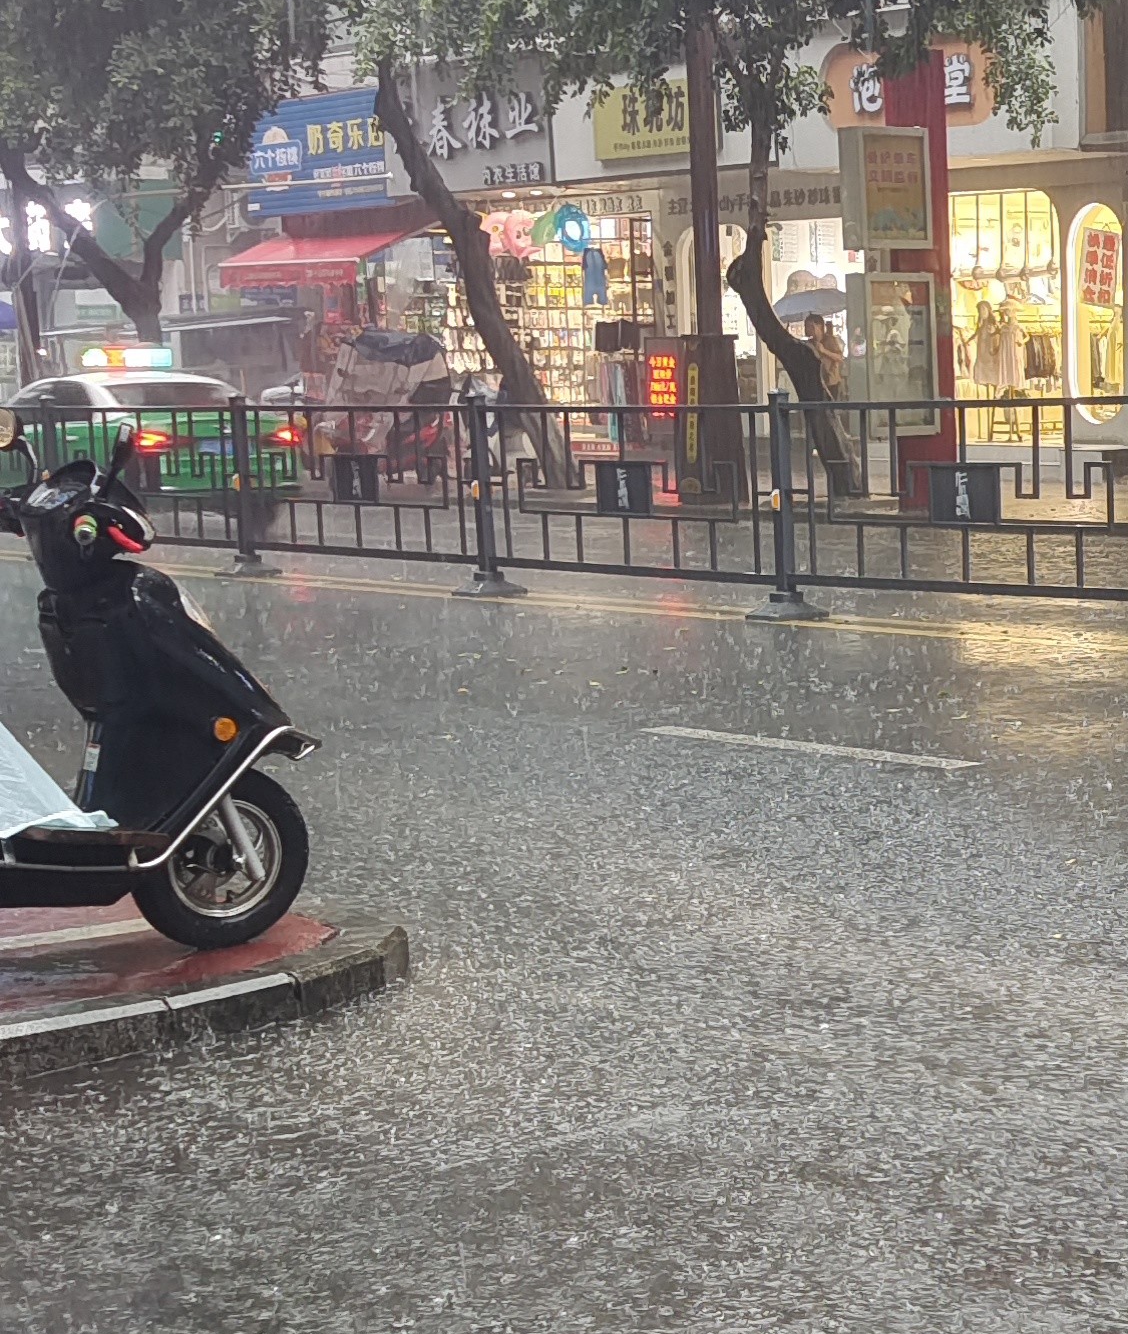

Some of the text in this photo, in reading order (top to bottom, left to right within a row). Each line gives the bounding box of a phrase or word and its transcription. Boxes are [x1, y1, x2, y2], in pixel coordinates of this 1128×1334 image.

[850, 54, 971, 113] 泡堂
[404, 92, 538, 160] 春袜业
